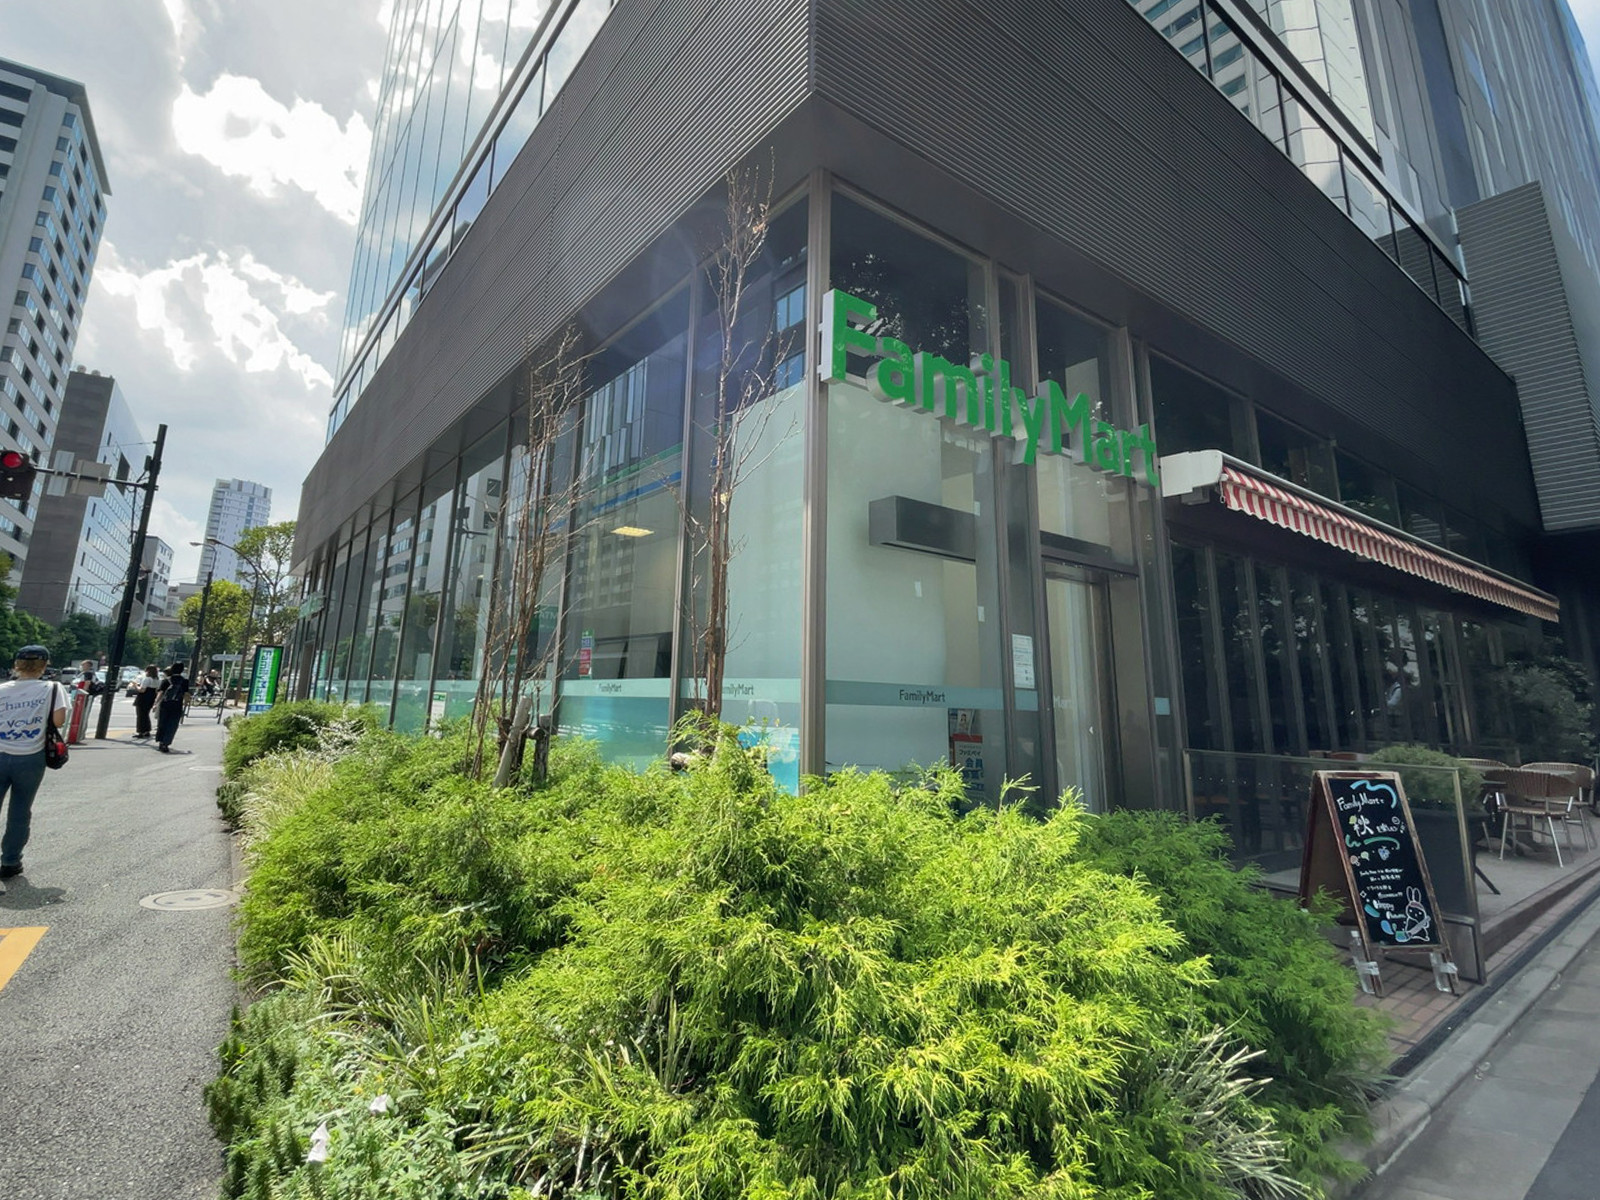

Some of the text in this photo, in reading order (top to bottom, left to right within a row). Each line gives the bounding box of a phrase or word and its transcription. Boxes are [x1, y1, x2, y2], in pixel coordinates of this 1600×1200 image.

[822, 288, 1159, 487] FamilyMart
[255, 650, 273, 703] FamilyMart
[899, 689, 946, 704] FamilyMart
